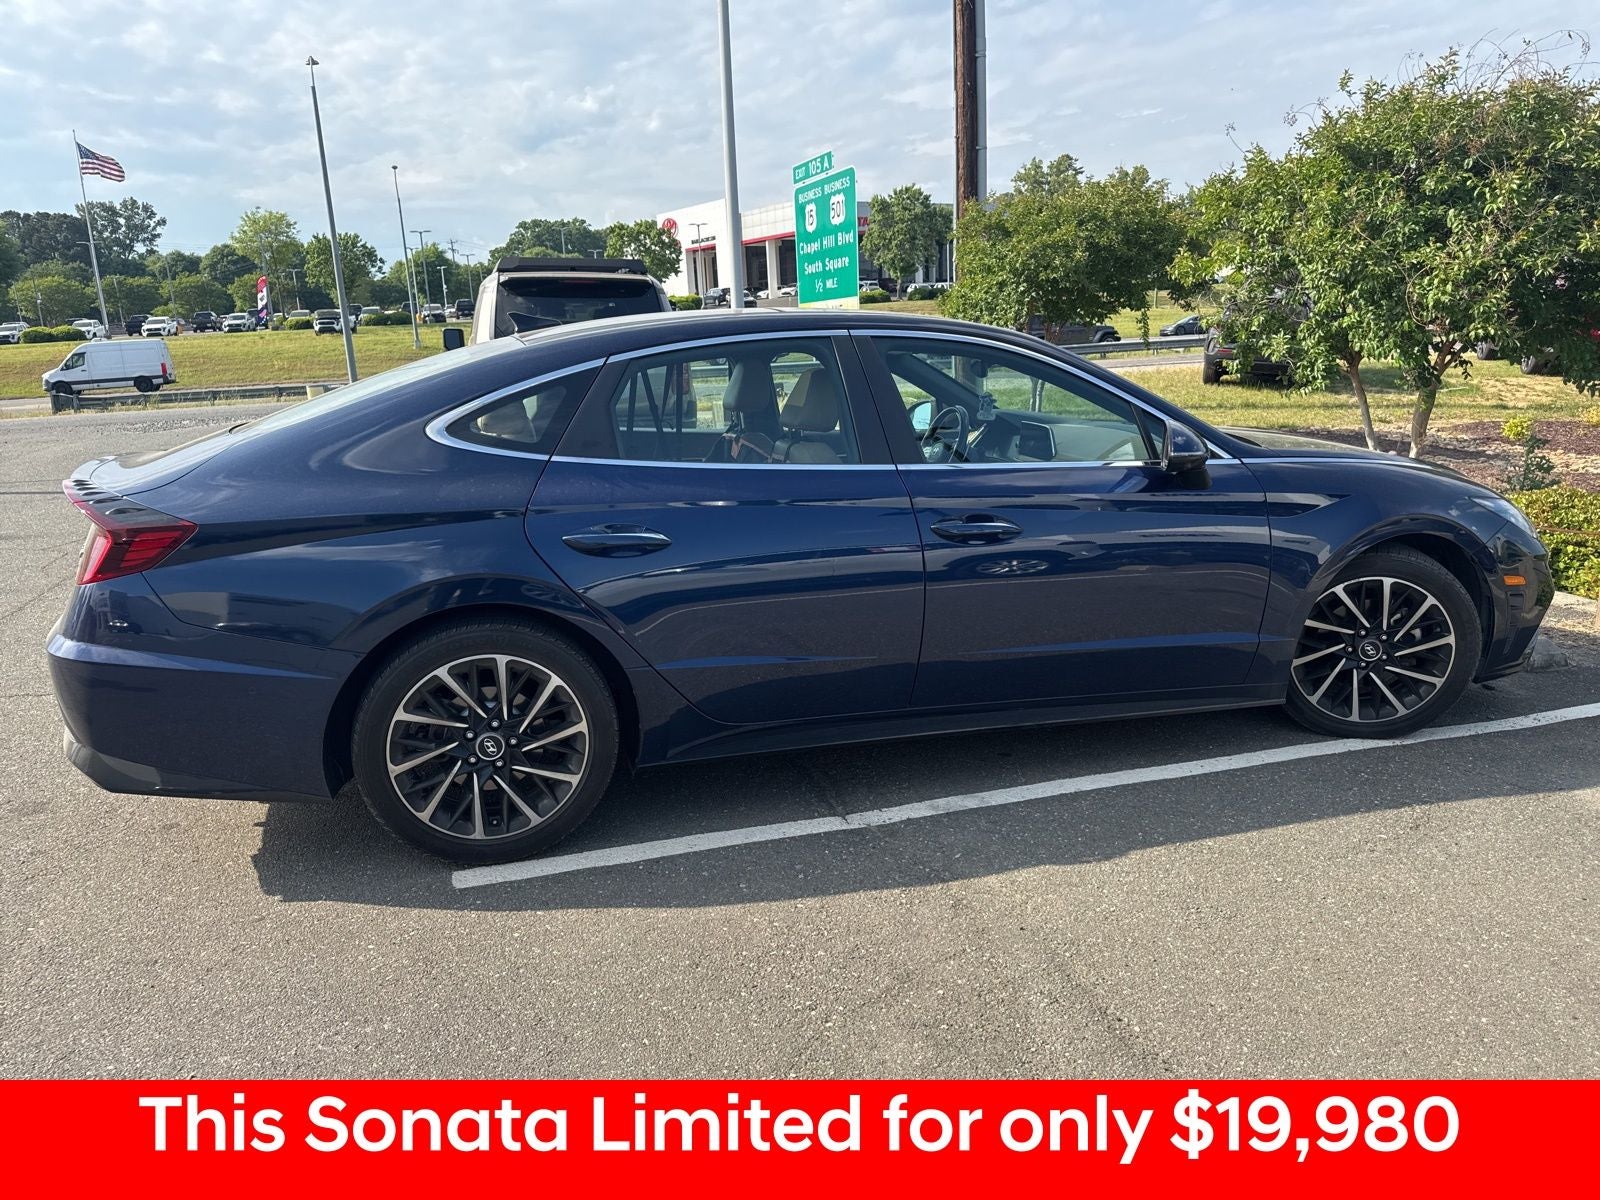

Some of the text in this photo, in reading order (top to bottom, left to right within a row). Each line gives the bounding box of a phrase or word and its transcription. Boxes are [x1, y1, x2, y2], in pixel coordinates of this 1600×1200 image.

[809, 158, 821, 176] 105
[823, 155, 830, 171] A
[798, 176, 850, 203] BUSINESS BUSINESS
[807, 199, 845, 226] 15 501
[799, 229, 854, 255] Chapel Hill Blvd
[804, 256, 849, 275] South Square
[825, 277, 838, 289] MILE
